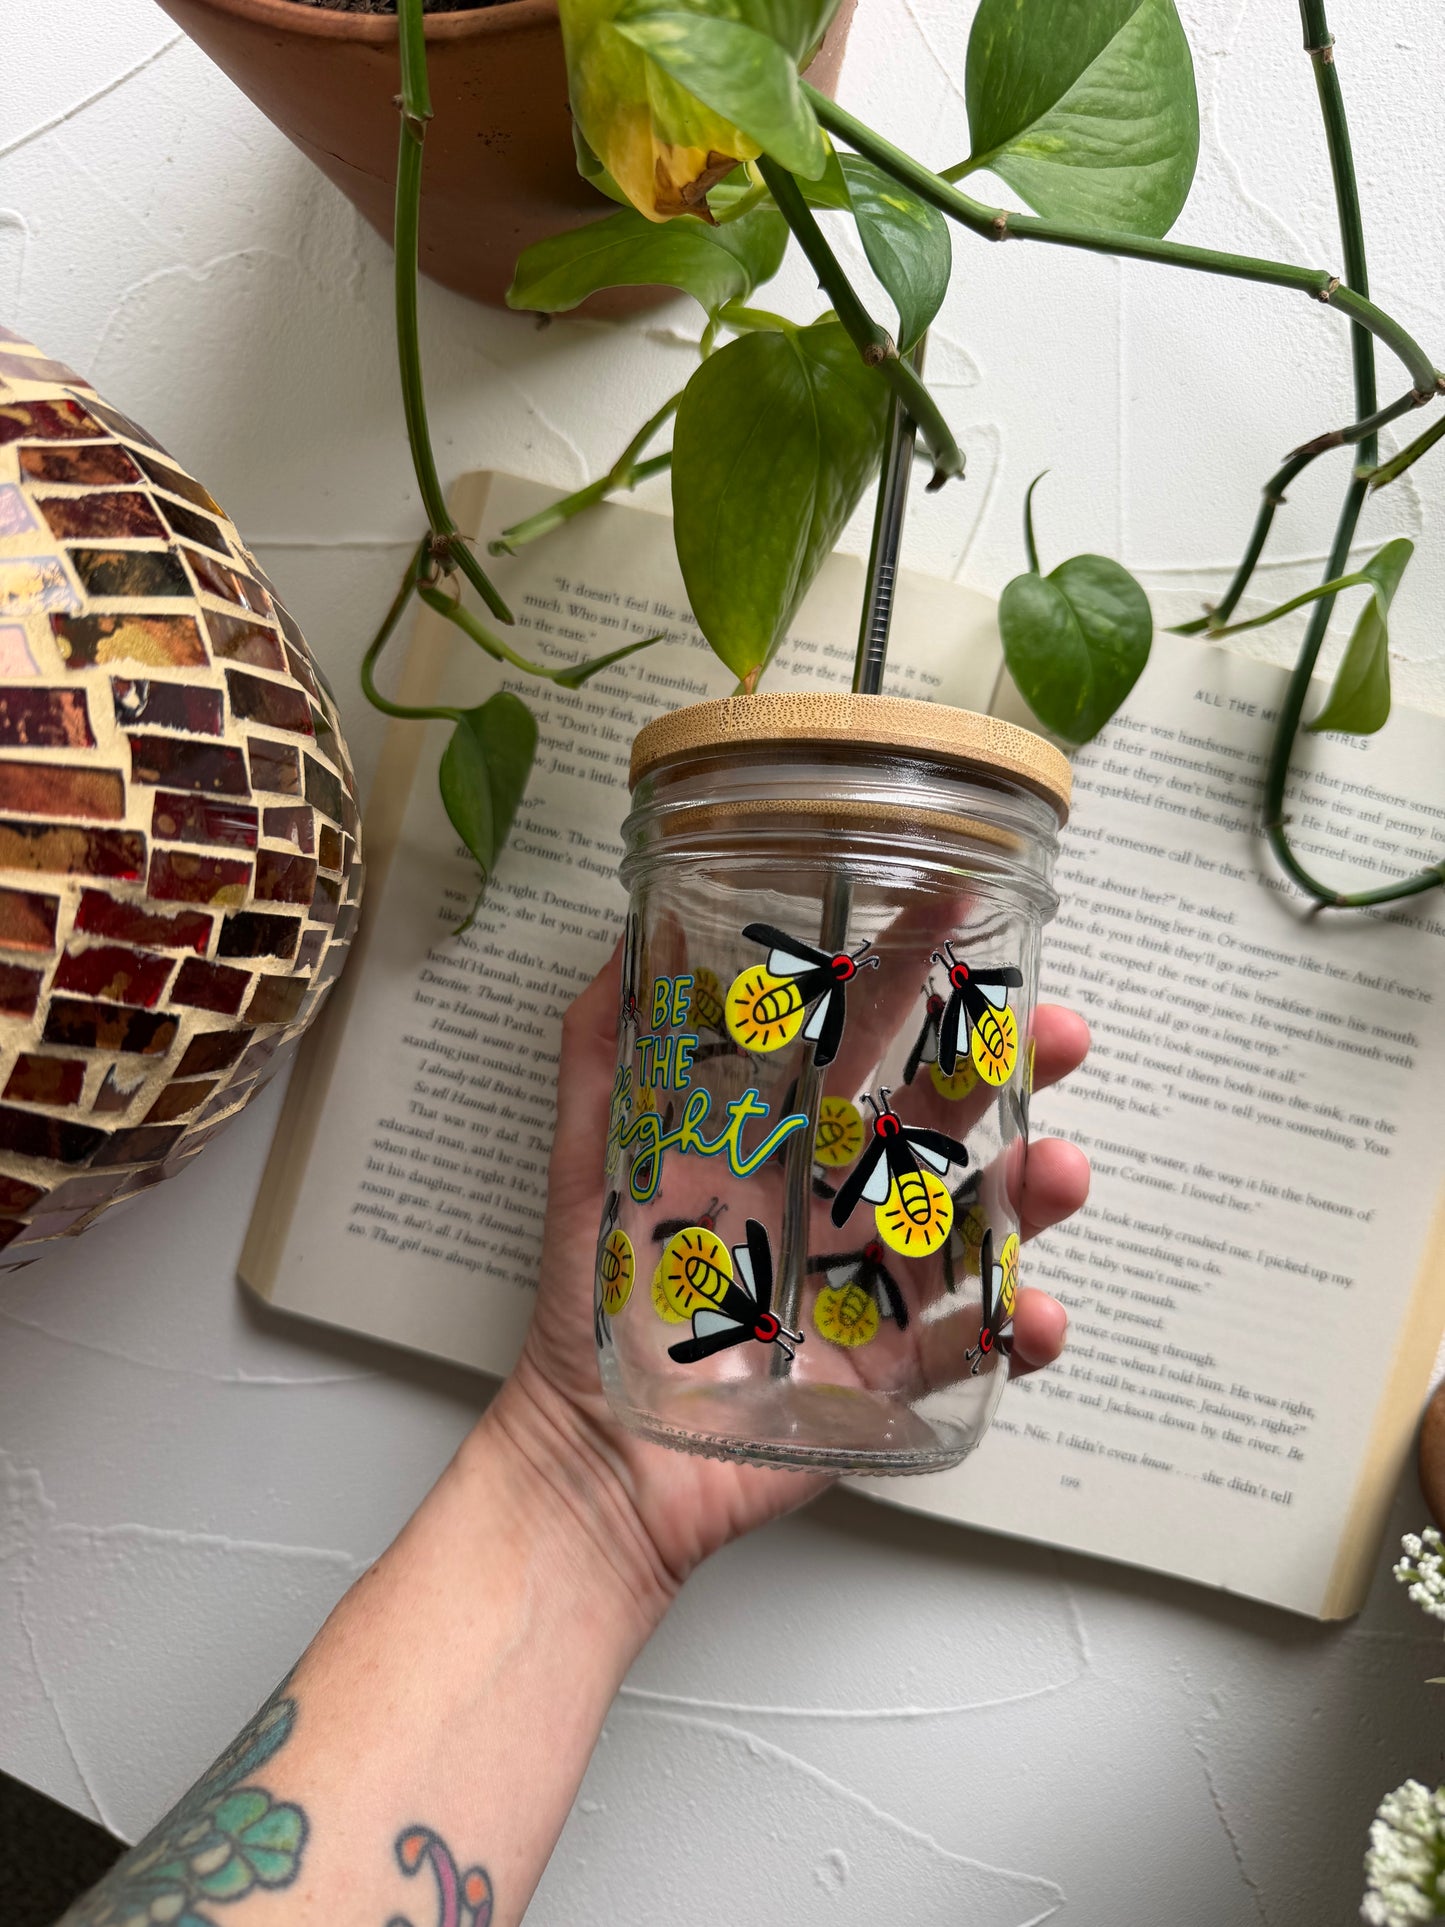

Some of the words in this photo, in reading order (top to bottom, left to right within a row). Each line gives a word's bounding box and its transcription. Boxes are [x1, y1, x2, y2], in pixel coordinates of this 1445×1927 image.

[567, 603, 598, 621] Who
[574, 584, 621, 605] doesn't
[623, 596, 649, 612] feel
[652, 602, 676, 619] like
[533, 619, 555, 633] the
[500, 679, 541, 697] poked
[553, 694, 584, 709] with
[599, 726, 623, 742] like
[1193, 690, 1223, 707] ALL
[1228, 699, 1257, 717] THE
[1325, 731, 1369, 751] GIRLS
[547, 758, 576, 775] Just
[588, 768, 618, 786] little
[576, 746, 611, 762] some
[1149, 726, 1176, 740] was
[1177, 730, 1246, 759] handsome
[1314, 772, 1342, 788] that
[1340, 782, 1408, 807] professors
[1112, 738, 1148, 756] their
[1149, 751, 1236, 784] mismatching
[1298, 789, 1329, 807] bow
[1330, 800, 1355, 816] ties
[1356, 811, 1384, 824] and
[1383, 818, 1427, 838] penny
[1101, 759, 1131, 775] that
[1132, 766, 1165, 786] they
[1165, 776, 1204, 795] don't
[1204, 785, 1250, 808] bother
[1324, 821, 1352, 838] had
[1371, 838, 1401, 854] easy
[567, 829, 593, 847] The
[1094, 785, 1153, 805] sparkled
[1153, 796, 1188, 815] from
[1189, 806, 1213, 822] the
[1212, 813, 1253, 832] slight
[1295, 840, 1348, 861] carried
[1346, 854, 1379, 870] with
[510, 838, 573, 864] Corinne's
[1105, 834, 1167, 857] someone
[1167, 850, 1193, 864] call
[1193, 854, 1218, 870] her
[1062, 870, 1098, 886] what
[1097, 878, 1139, 897] about
[541, 890, 602, 917] Detective
[513, 907, 537, 921] she
[539, 912, 557, 927] let
[558, 922, 583, 935] you
[586, 929, 609, 942] call
[1054, 915, 1085, 929] who
[1106, 930, 1134, 944] you
[1135, 935, 1173, 954] think
[1173, 946, 1216, 966] they'll
[425, 947, 472, 970] herself
[481, 943, 505, 957] she
[548, 962, 577, 978] And
[1089, 902, 1133, 919] gonna
[1133, 909, 1171, 933] bring
[1171, 920, 1197, 936] her
[1238, 942, 1298, 965] someone
[1297, 956, 1324, 973] like
[1351, 971, 1383, 989] And
[1395, 986, 1433, 1003] we're
[651, 975, 695, 1031] BE
[1098, 952, 1155, 973] scooped
[1156, 965, 1180, 980] the
[1182, 974, 1209, 988] rest
[1229, 983, 1251, 999] his
[1253, 991, 1314, 1017] breakfast
[1315, 1011, 1345, 1025] into
[1346, 1016, 1369, 1032] his
[1078, 966, 1109, 983] half
[1115, 978, 1149, 995] glass
[1165, 994, 1212, 1013] orange
[1272, 1023, 1315, 1041] wiped
[1313, 1030, 1337, 1046] his
[1335, 1040, 1383, 1059] mouth
[1107, 999, 1153, 1020] should
[1221, 1029, 1253, 1049] long
[400, 1036, 456, 1060] standing
[480, 1058, 527, 1076] outside
[636, 1034, 698, 1091] THE
[1101, 1023, 1163, 1046] wouldn't
[1162, 1036, 1193, 1056] look
[1194, 1049, 1262, 1073] suspicious
[409, 1100, 439, 1119] That
[1067, 1086, 1126, 1110] anything
[1112, 1051, 1140, 1064] and
[1141, 1057, 1184, 1076] tossed
[1185, 1068, 1221, 1086] them
[1223, 1076, 1256, 1095] both
[1256, 1089, 1287, 1103] into
[1287, 1095, 1312, 1110] the
[1373, 1119, 1397, 1134] the
[377, 1118, 435, 1141] educated
[1177, 1091, 1211, 1106] want
[1230, 1105, 1254, 1118] tell
[1255, 1112, 1284, 1127] you
[1363, 1138, 1391, 1156] You
[372, 1139, 408, 1156] when
[431, 1155, 461, 1171] time
[508, 1176, 539, 1195] He's
[1093, 1139, 1148, 1163] running
[1304, 1193, 1355, 1216] bottom
[1082, 1227, 1114, 1245] have
[1115, 1240, 1185, 1267] something
[1100, 1208, 1132, 1227] look
[1131, 1221, 1174, 1239] nearly
[1173, 1232, 1228, 1253] crushed
[1263, 1256, 1310, 1275] picked
[1036, 1261, 1088, 1287] halfway
[1087, 1252, 1120, 1272] baby
[1121, 1264, 1164, 1282] wasn't
[1074, 1323, 1110, 1339] voice
[1109, 1333, 1160, 1355] coming
[1068, 1364, 1093, 1381] It'd
[1093, 1374, 1119, 1388] still
[1119, 1357, 1157, 1374] when
[1166, 1370, 1195, 1384] told
[1038, 1380, 1073, 1400] Tyler
[1076, 1394, 1103, 1407] and
[1102, 1398, 1156, 1421] Jackson
[1157, 1412, 1197, 1431] down
[1064, 1435, 1105, 1454] didn't
[1105, 1449, 1138, 1464] even
[1139, 1453, 1173, 1472] know
[1201, 1470, 1224, 1486] she
[1226, 1477, 1268, 1498] didn't
[1269, 1491, 1293, 1505] tell
